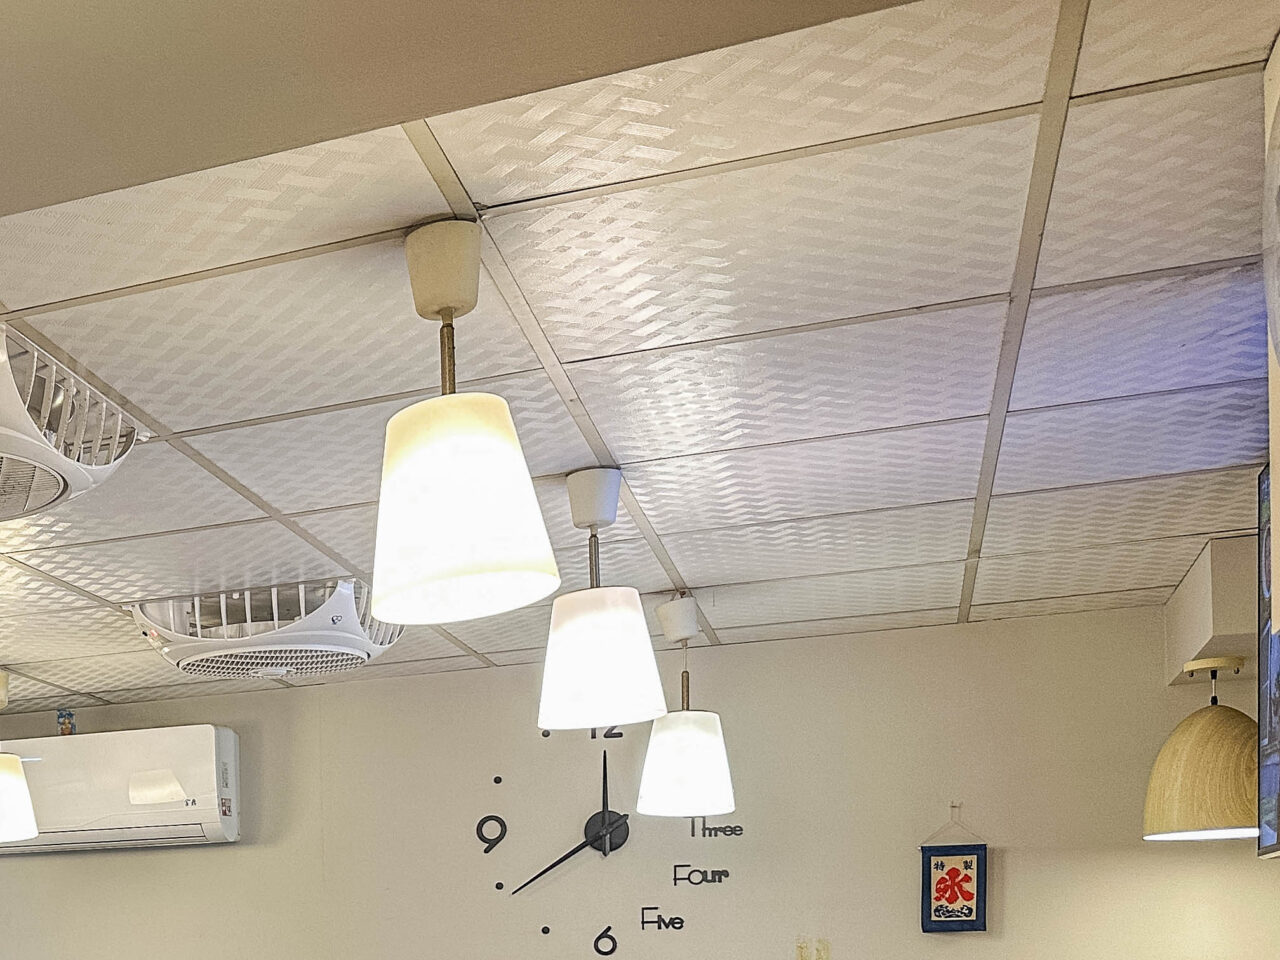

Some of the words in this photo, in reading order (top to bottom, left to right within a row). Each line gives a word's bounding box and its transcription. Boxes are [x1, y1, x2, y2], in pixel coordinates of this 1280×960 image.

[476, 815, 507, 854] 9
[683, 816, 744, 837] Three
[673, 864, 729, 886] Four
[641, 906, 684, 930] Five
[593, 925, 618, 956] 6
